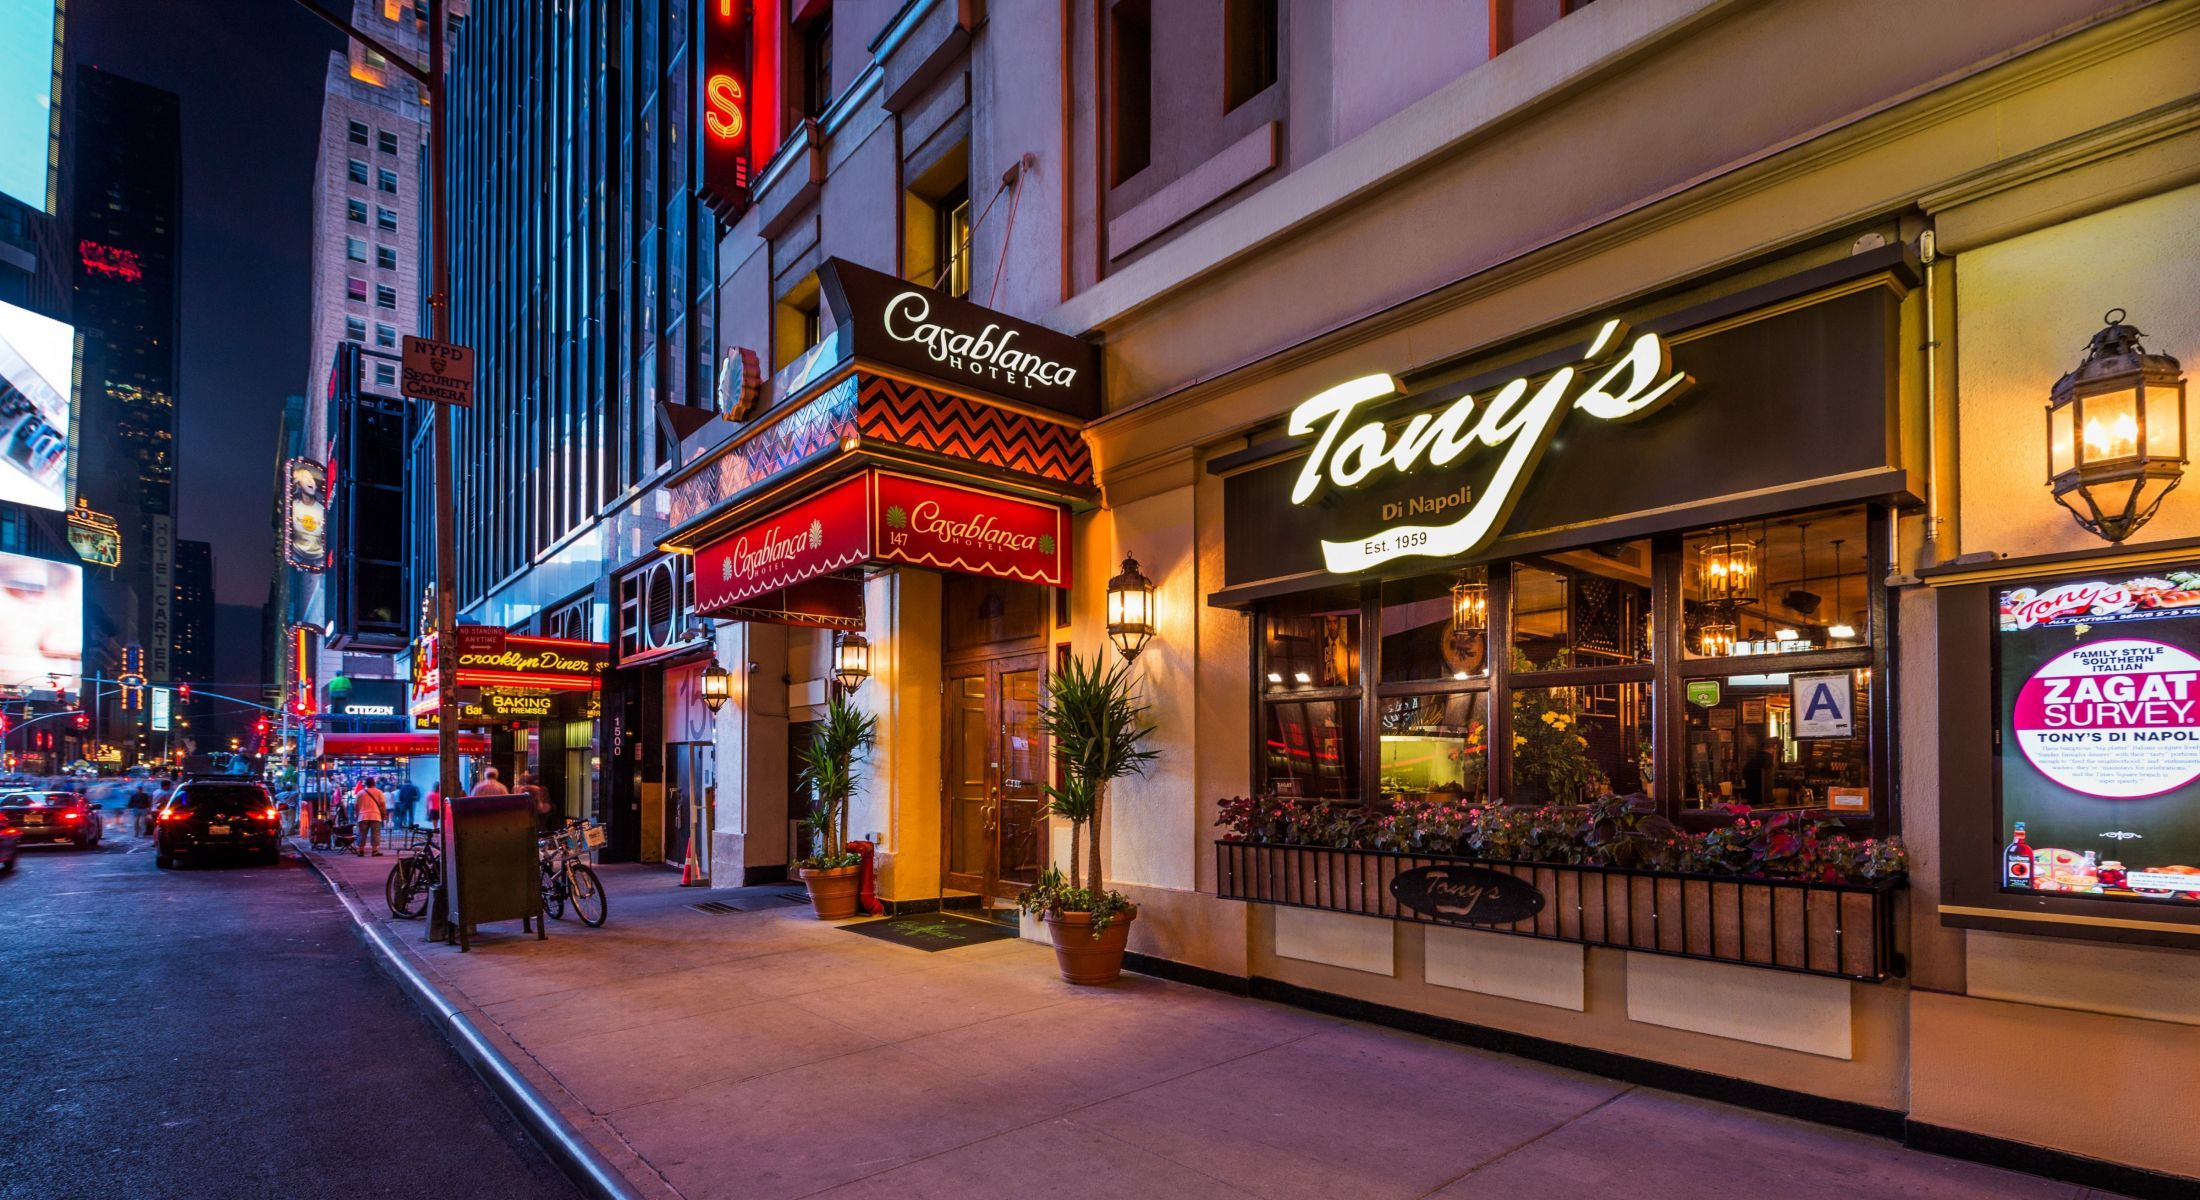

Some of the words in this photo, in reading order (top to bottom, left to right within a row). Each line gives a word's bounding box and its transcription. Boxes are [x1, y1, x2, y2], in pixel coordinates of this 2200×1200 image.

[884, 291, 1077, 387] Casablanca
[414, 341, 463, 360] NYPD
[949, 354, 1032, 389] HOTEL
[1287, 318, 1687, 574] Tony's
[1382, 501, 1402, 520] Di
[1409, 485, 1471, 515] Napoli
[911, 500, 1036, 551] Casablanca
[890, 531, 908, 546] 147
[952, 537, 1003, 552] HOTEL
[1365, 540, 1389, 555] Est.
[1395, 531, 1427, 549] 1959
[155, 523, 168, 588] HOTEL
[733, 526, 807, 580] Casablanca
[754, 562, 785, 577] HOTEL
[2018, 588, 2123, 623] Tony's
[2068, 615, 2115, 623] PLATTERS
[154, 594, 167, 673] CARTER
[540, 652, 589, 671] Diner
[2073, 649, 2118, 659] FAMILY
[2122, 646, 2164, 656] STYLE
[2082, 655, 2154, 665] SOUTHERN
[2092, 663, 2143, 672] ITALIAN
[2043, 672, 2197, 704] ZAGAT
[344, 704, 394, 715] CITIZEN
[493, 696, 551, 708] BAKING
[1803, 682, 1843, 720] A
[510, 707, 548, 715] PREMISES
[2037, 732, 2102, 743] TONY'S
[2109, 731, 2126, 742] DI
